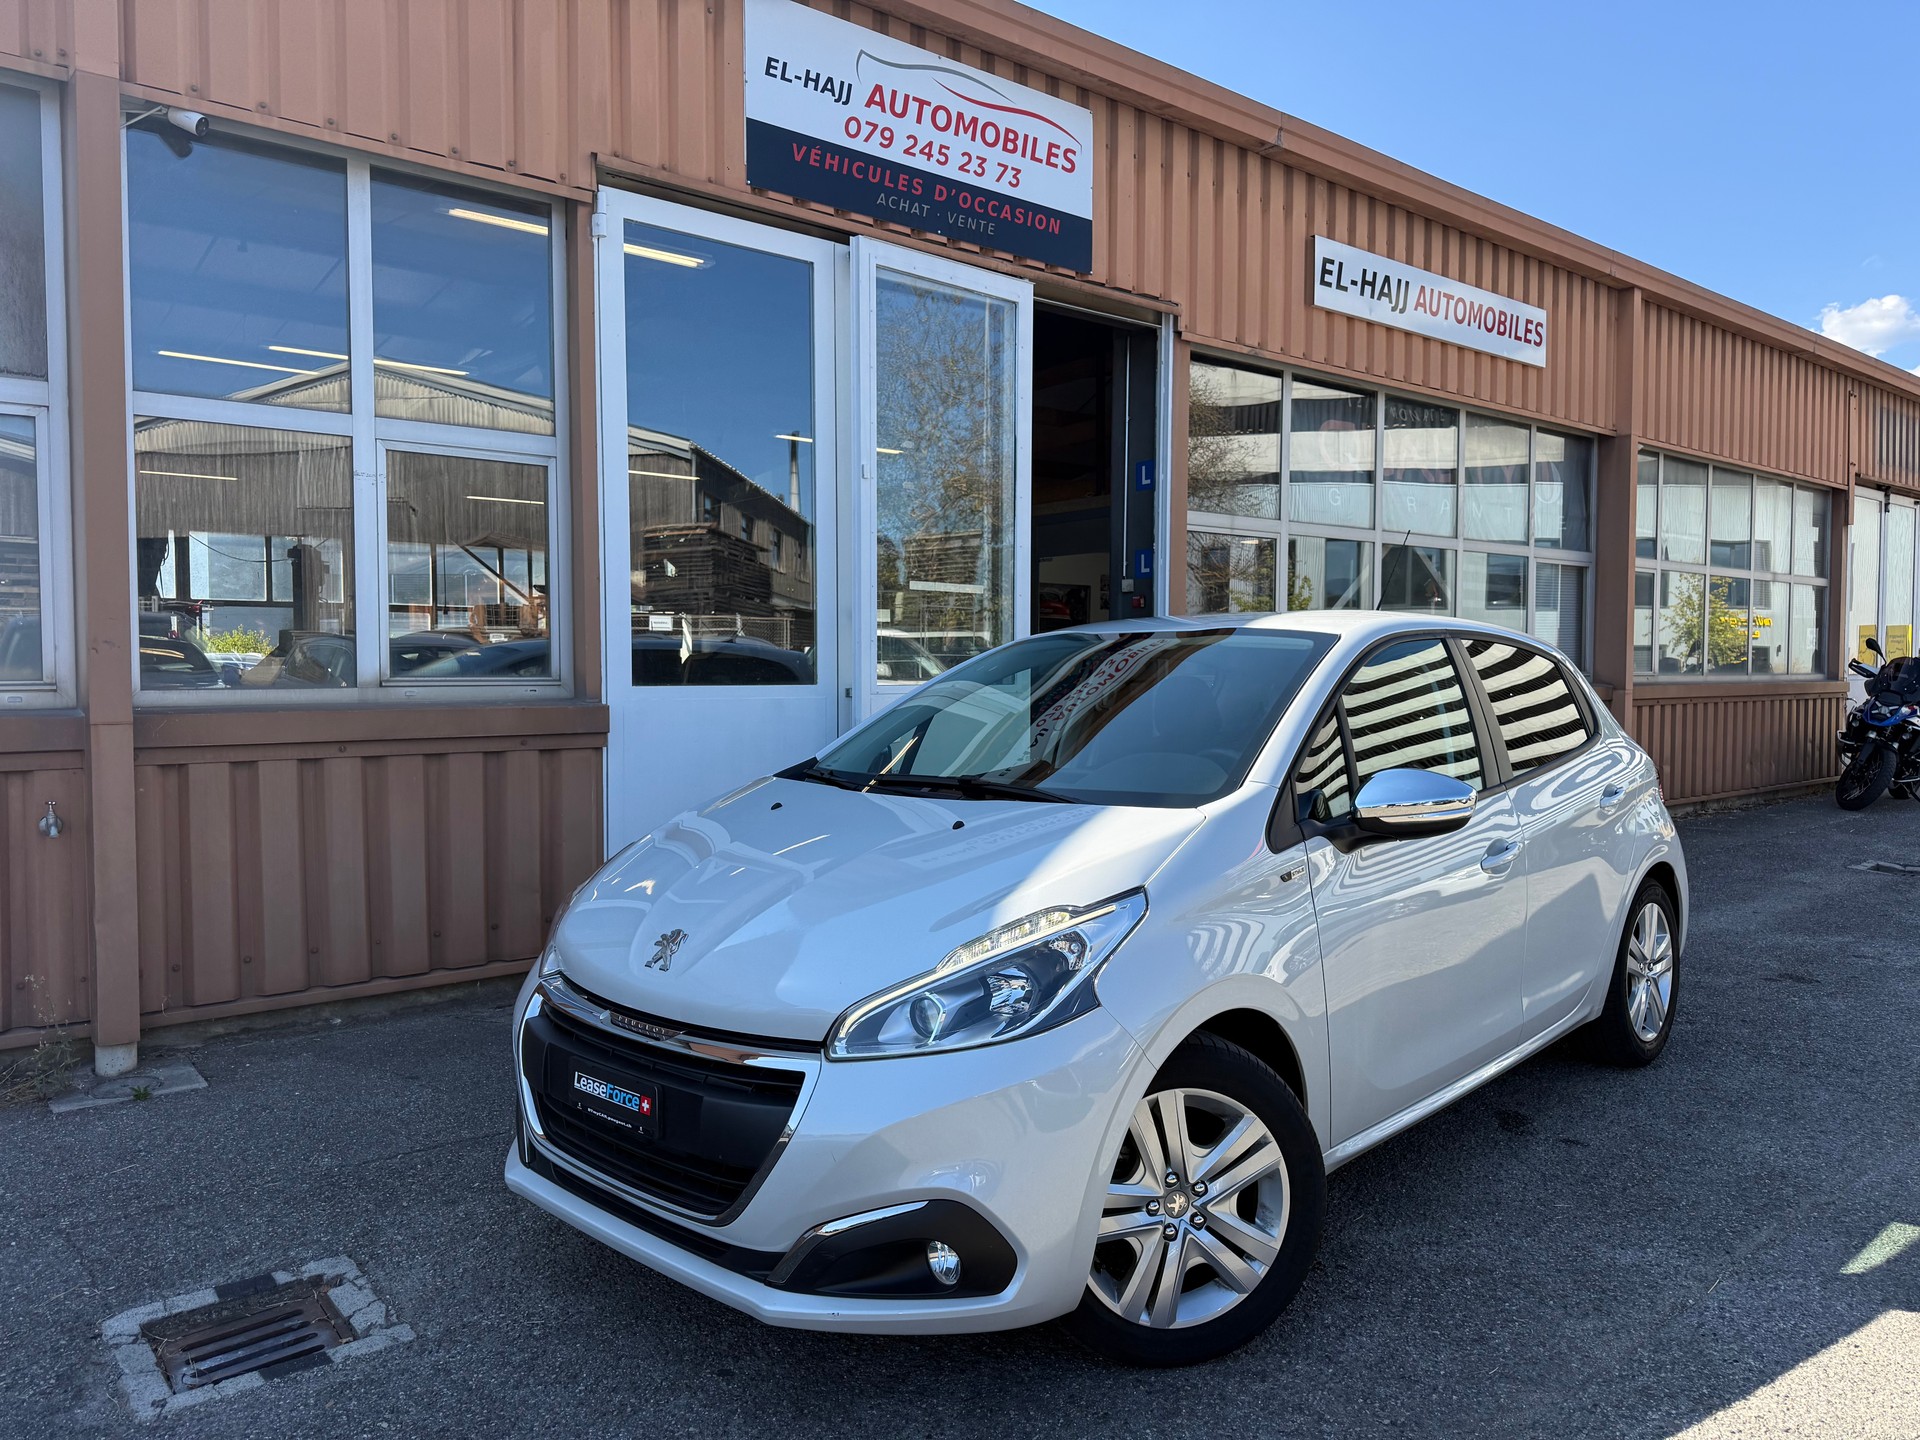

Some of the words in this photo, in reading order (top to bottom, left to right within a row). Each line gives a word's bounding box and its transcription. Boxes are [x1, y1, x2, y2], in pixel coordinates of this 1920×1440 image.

[764, 56, 853, 106] EL-HAJJ
[864, 83, 1078, 174] AUTOMOBILES
[844, 116, 895, 150] 079
[903, 134, 950, 167] 245
[957, 152, 987, 178] 23
[996, 162, 1022, 189] 73
[791, 143, 923, 195] VÉHICULES
[933, 185, 1062, 235] D'OCCASION
[876, 193, 931, 218] ACHAT
[947, 212, 996, 236] VENTE
[1319, 256, 1410, 314] EL-HAJJ
[1413, 285, 1544, 348] AUTOMOBILES
[1141, 465, 1151, 485] L
[1140, 554, 1150, 573] L
[574, 1071, 640, 1110] LeaseForce
